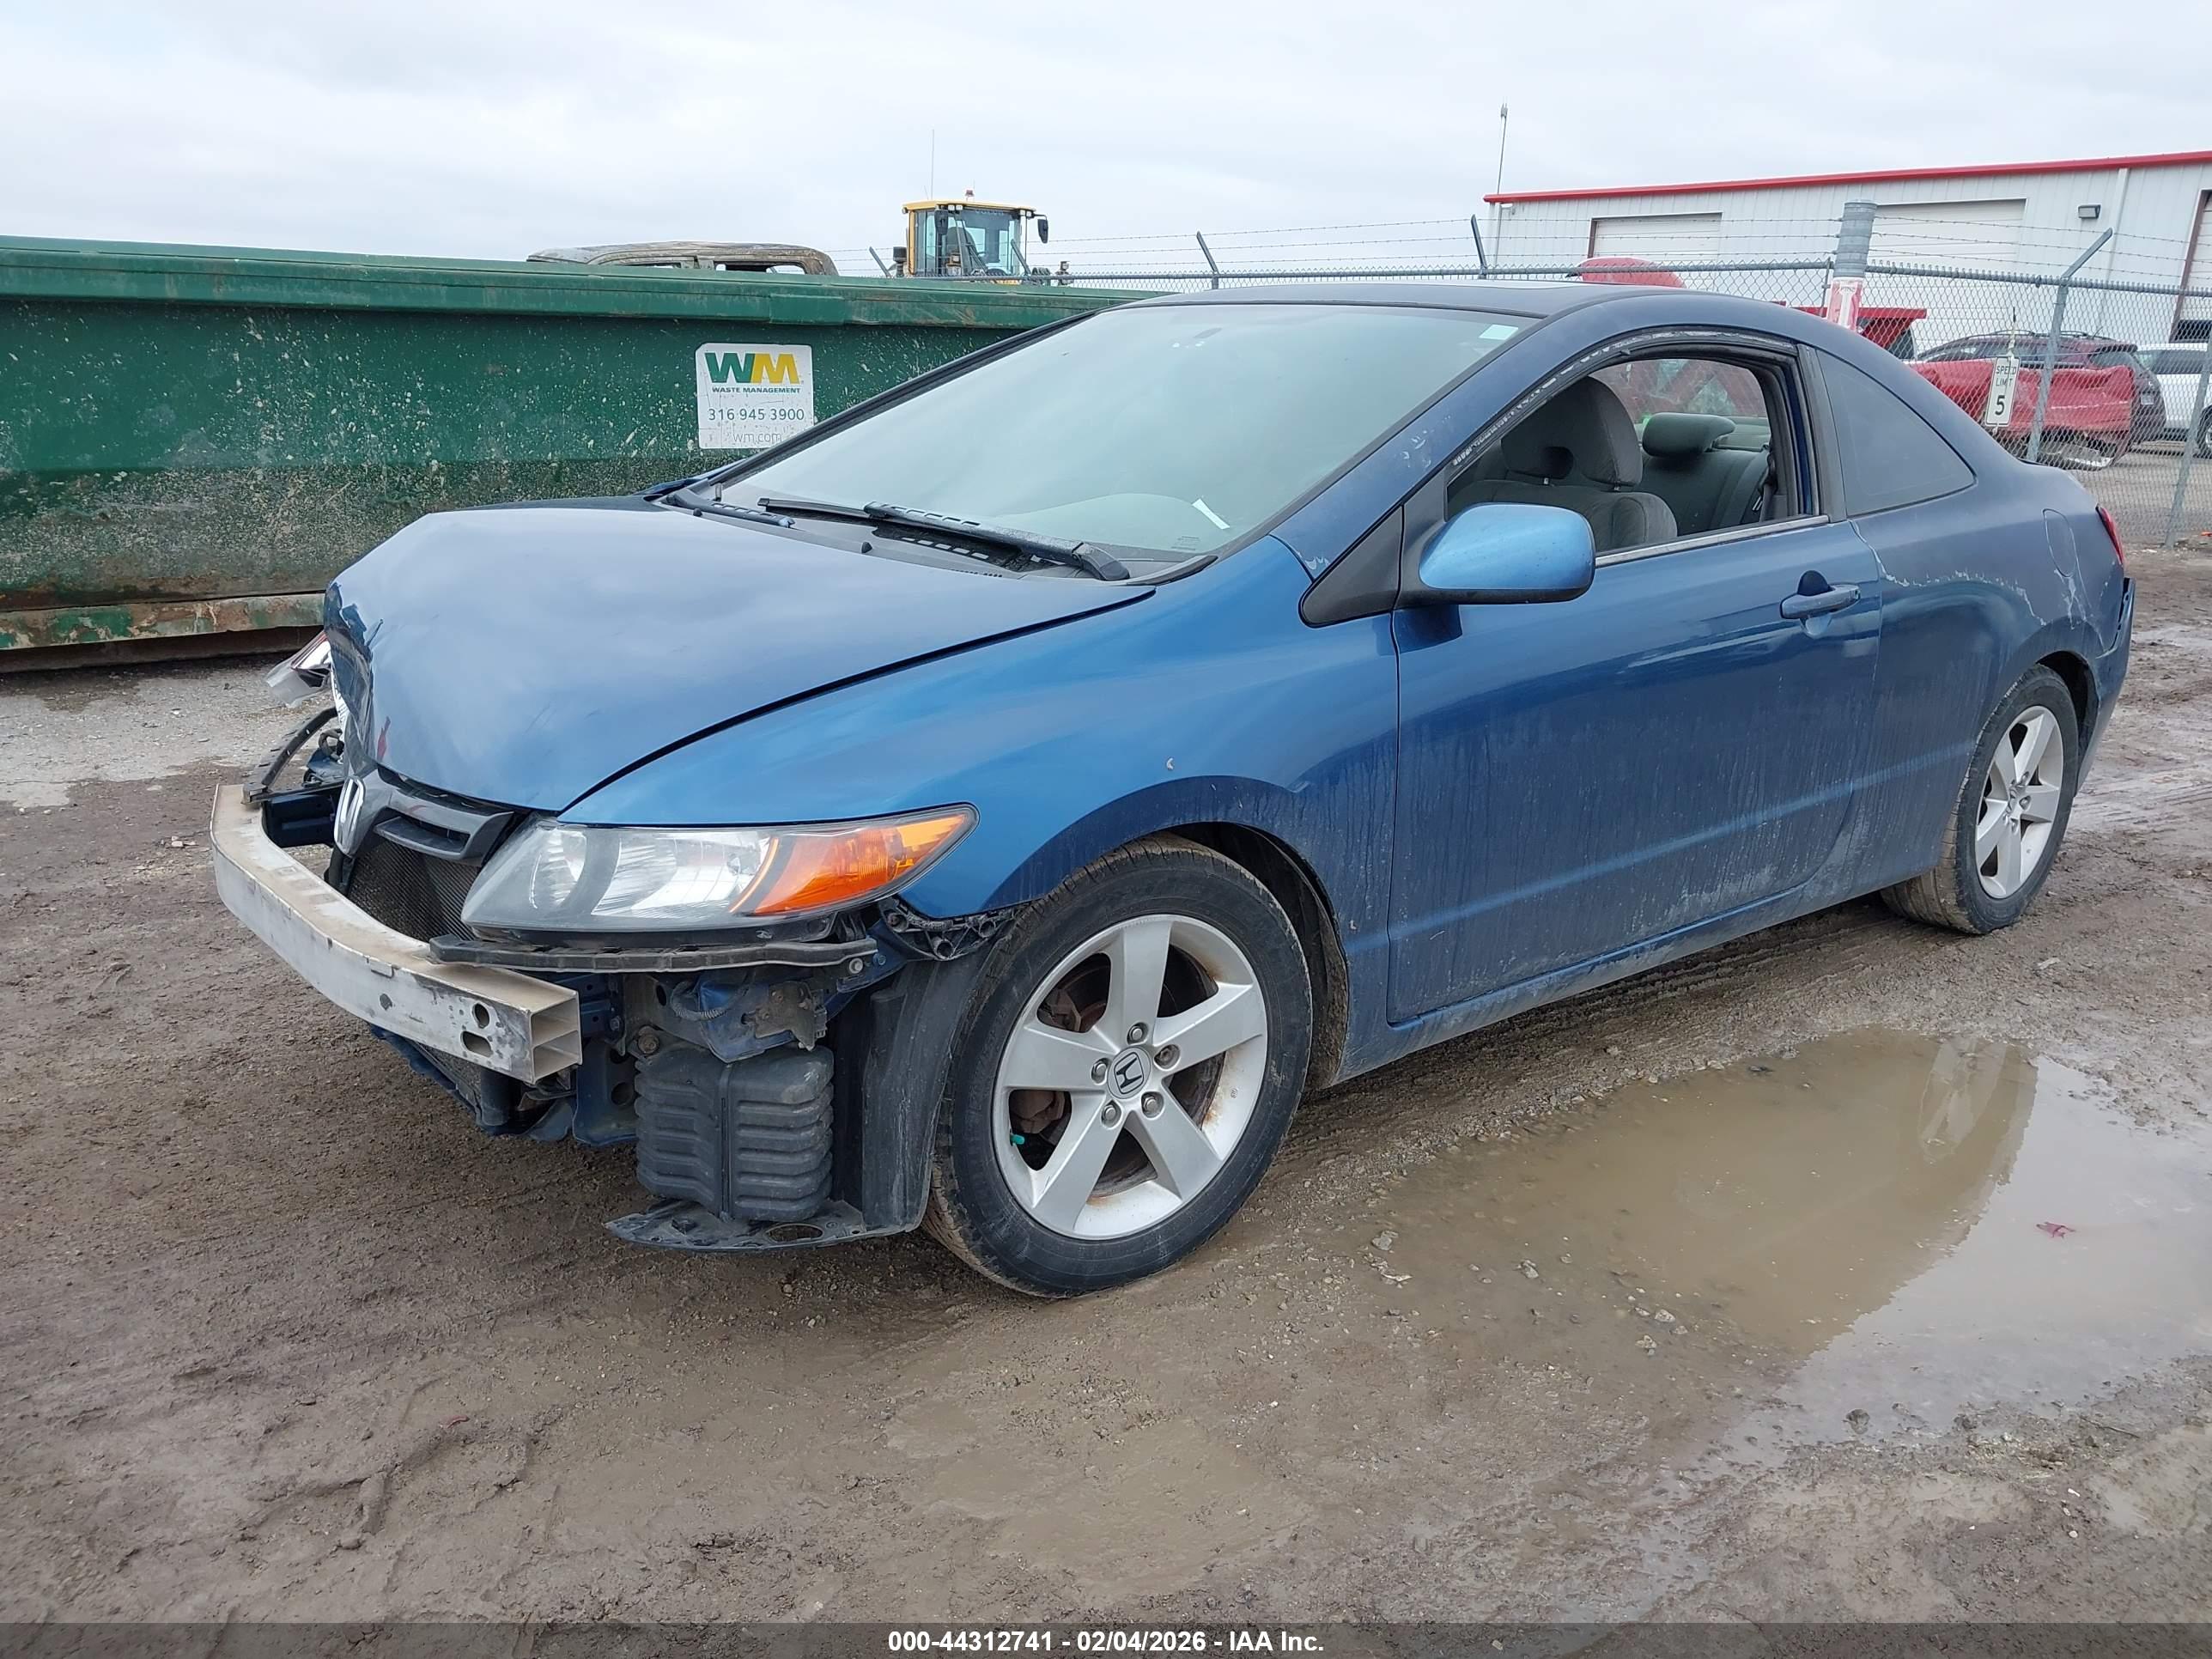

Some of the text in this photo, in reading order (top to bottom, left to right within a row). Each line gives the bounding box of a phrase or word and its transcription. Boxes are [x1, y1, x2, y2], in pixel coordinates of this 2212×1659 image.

[704, 352, 800, 385] WM
[1996, 378, 2013, 386] LIMT
[1995, 395, 2006, 416] 5
[708, 408, 805, 421] 316 945 3900
[732, 432, 782, 443] wm.com
